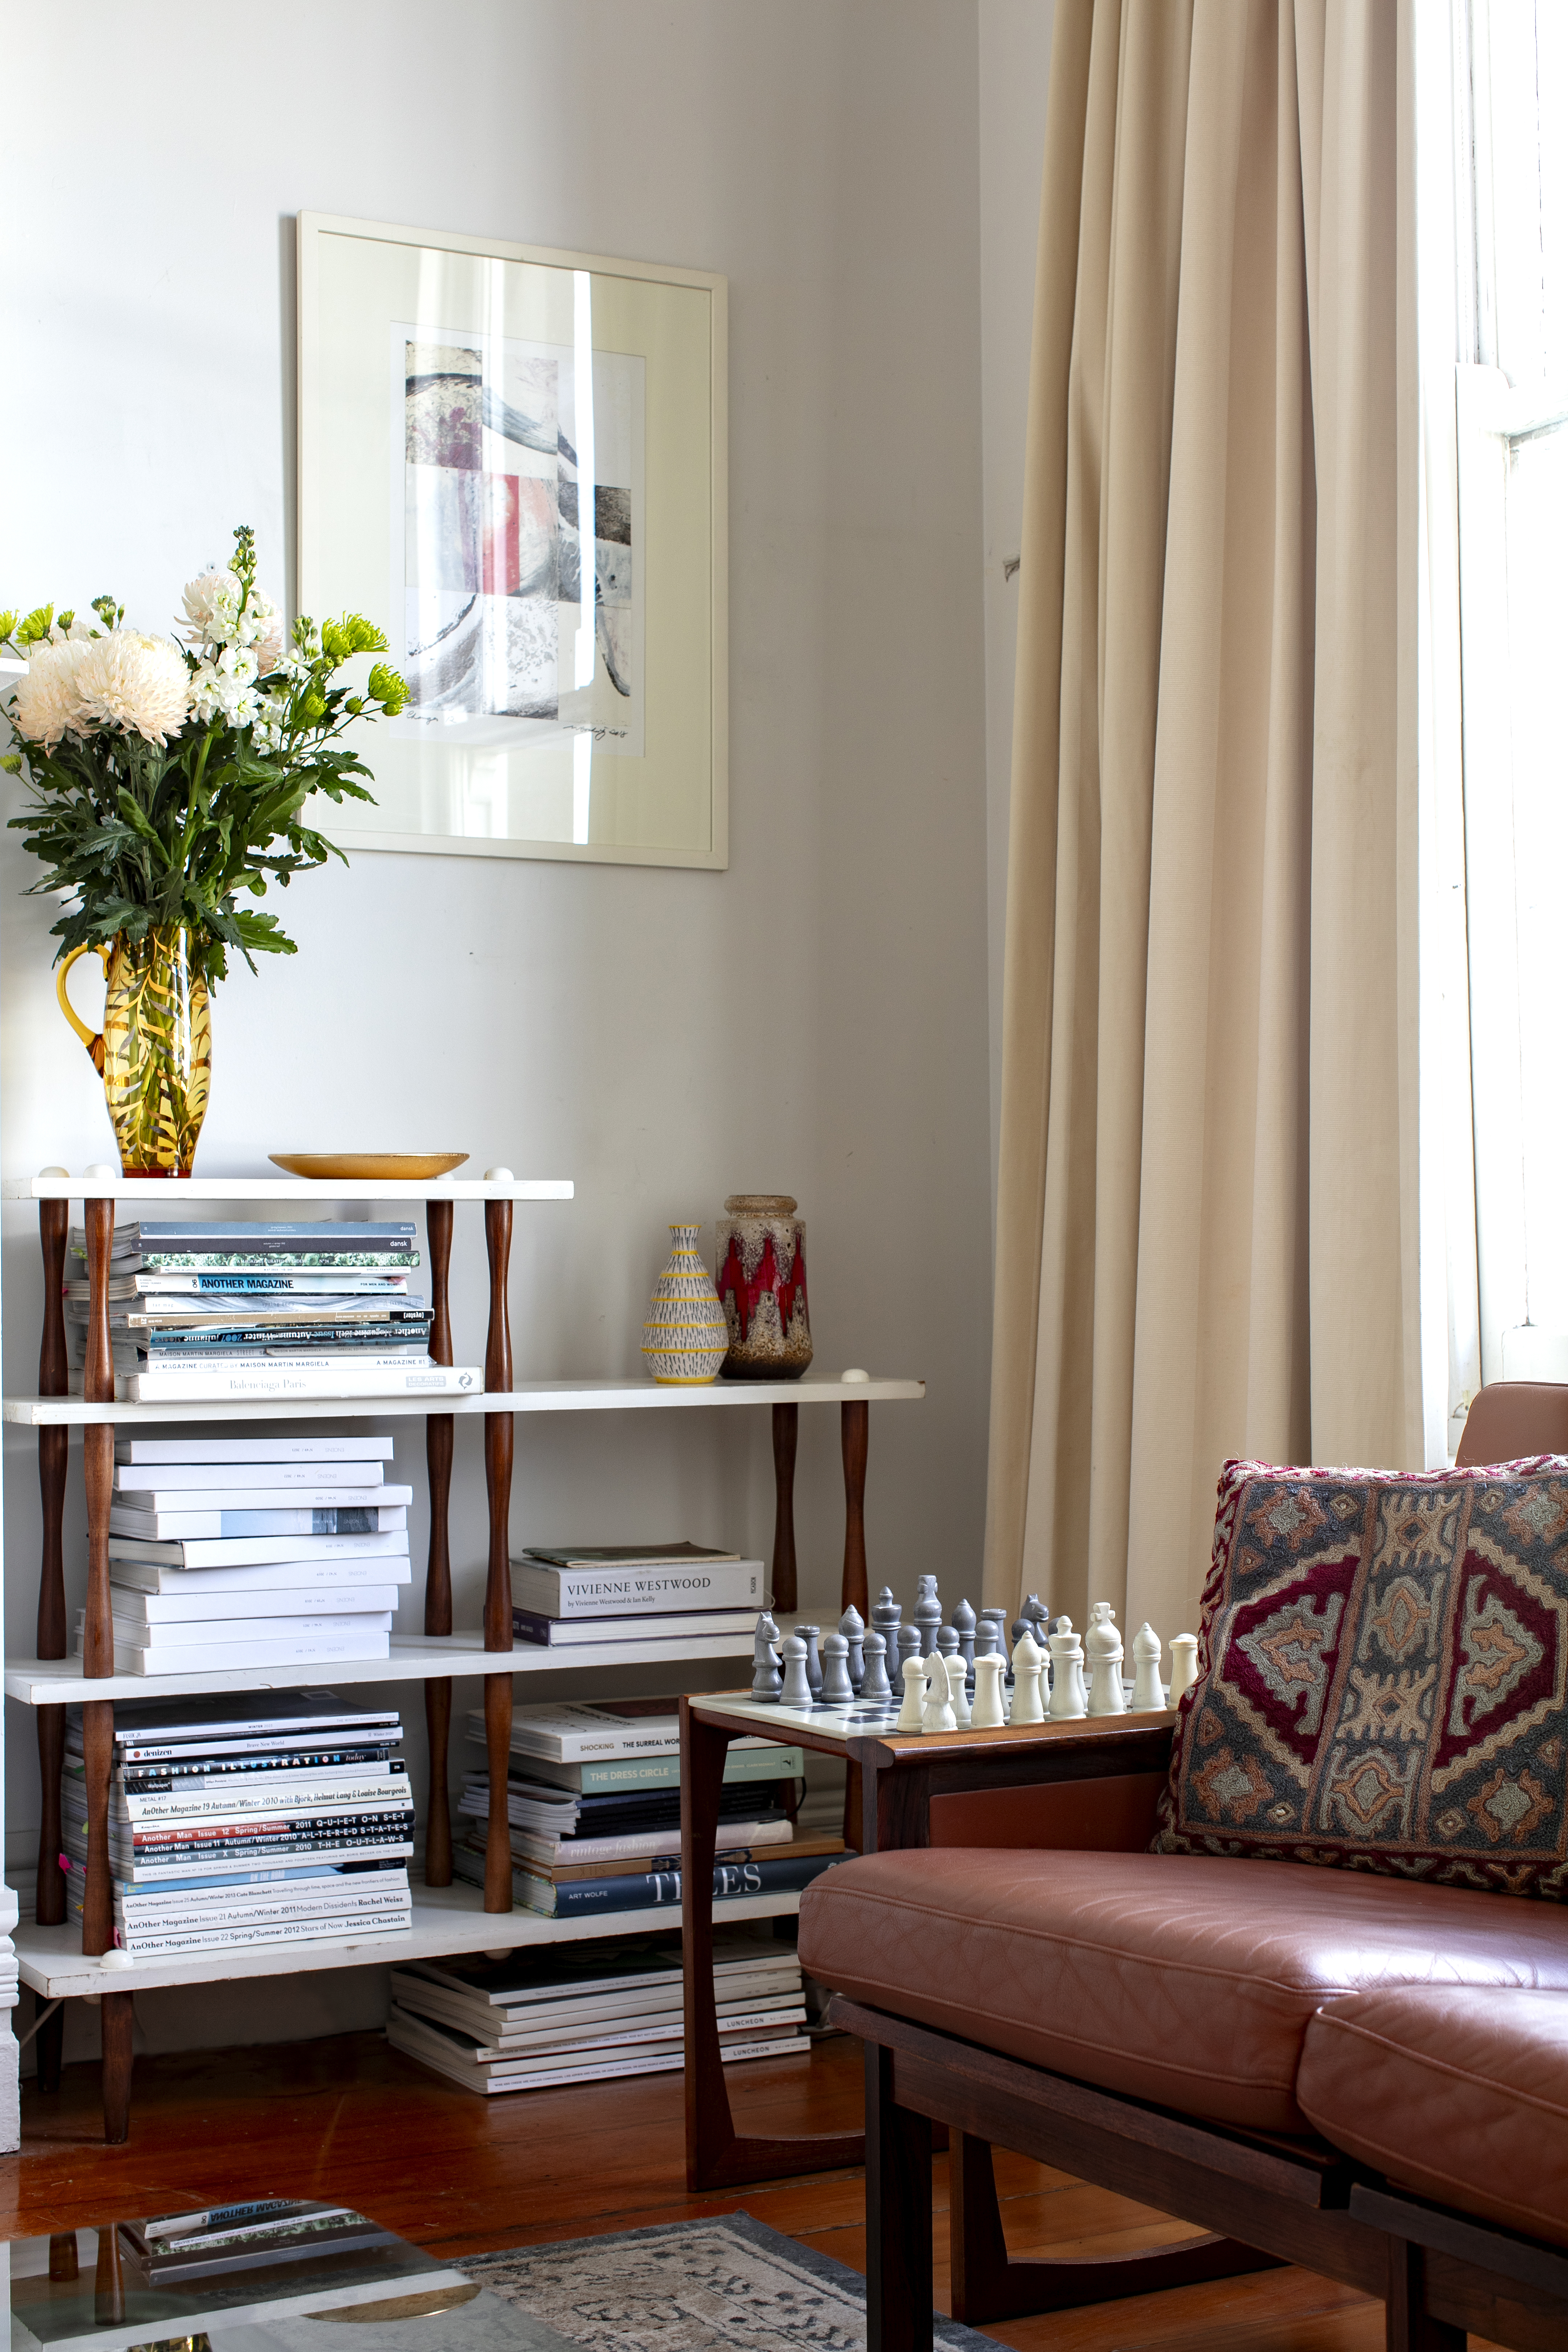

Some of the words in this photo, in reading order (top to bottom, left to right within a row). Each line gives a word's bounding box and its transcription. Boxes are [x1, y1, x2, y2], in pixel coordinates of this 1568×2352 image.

[201, 1279, 244, 1288] ANOTHER
[247, 1279, 294, 1289] MAGAZINE
[184, 1333, 220, 1343] Julianne
[220, 1333, 243, 1342] 2007
[354, 1327, 392, 1338] Magazine
[395, 1328, 427, 1336] Another
[230, 1380, 280, 1392] Balenciaga
[283, 1379, 306, 1389] Paris
[567, 1582, 630, 1595] VIVIENNE
[635, 1577, 711, 1592] WESTWOOD
[580, 1743, 614, 1752] SHOCKING
[636, 1739, 663, 1748] SURREAL
[144, 1749, 172, 1757] denizen
[138, 1765, 210, 1777] FASHION
[222, 1755, 340, 1771] ILLUSTRATION
[346, 1752, 366, 1762] today
[590, 1772, 608, 1781] THE
[610, 1770, 637, 1780] DRESS
[639, 1767, 669, 1778] CIRCLE
[142, 1807, 169, 1815] AnOther
[171, 1804, 201, 1813] Magazine
[211, 1799, 260, 1810] Autumn/Winter
[262, 1797, 278, 1805] 2010
[279, 1795, 293, 1804] with
[294, 1793, 313, 1804] Björk,
[314, 1793, 335, 1801] Helmut
[358, 1789, 376, 1797] Louise
[377, 1786, 407, 1795] Bourgeois
[235, 1824, 290, 1834] Spring/Summer
[317, 1817, 356, 1827] Q-U-I-E-T
[383, 1812, 405, 1821] S-E-T
[225, 1836, 279, 1846] Autumn/Winter
[301, 1828, 358, 1839] A-L-T-E-R-E-D
[360, 1823, 408, 1834] S-T-A-T-E-S
[235, 1846, 289, 1857] Spring/Summer
[318, 1840, 340, 1849] T-H-E
[346, 1835, 404, 1846] O-U-T-L-A-W-S
[571, 1844, 612, 1857] vintage
[613, 1838, 656, 1857] fashion
[250, 1874, 258, 1882] ON
[260, 1872, 269, 1881] THE
[271, 1870, 285, 1879] ROAD
[646, 1864, 761, 1902] TES
[127, 1921, 161, 1930] AnOther
[162, 1917, 199, 1927] Magazine
[228, 1908, 279, 1919] Autumn/Winter
[323, 1901, 357, 1910] Dissidents
[358, 1897, 382, 1906] Rachel
[130, 1942, 164, 1950] AnOther
[165, 1937, 201, 1947] Magazine
[230, 1930, 282, 1941] Spring/Summer
[344, 1919, 371, 1928] Jessica
[372, 1915, 405, 1924] Chastain
[727, 2018, 764, 2027] LUNCHEON
[733, 2046, 769, 2056] LUNCHEON
